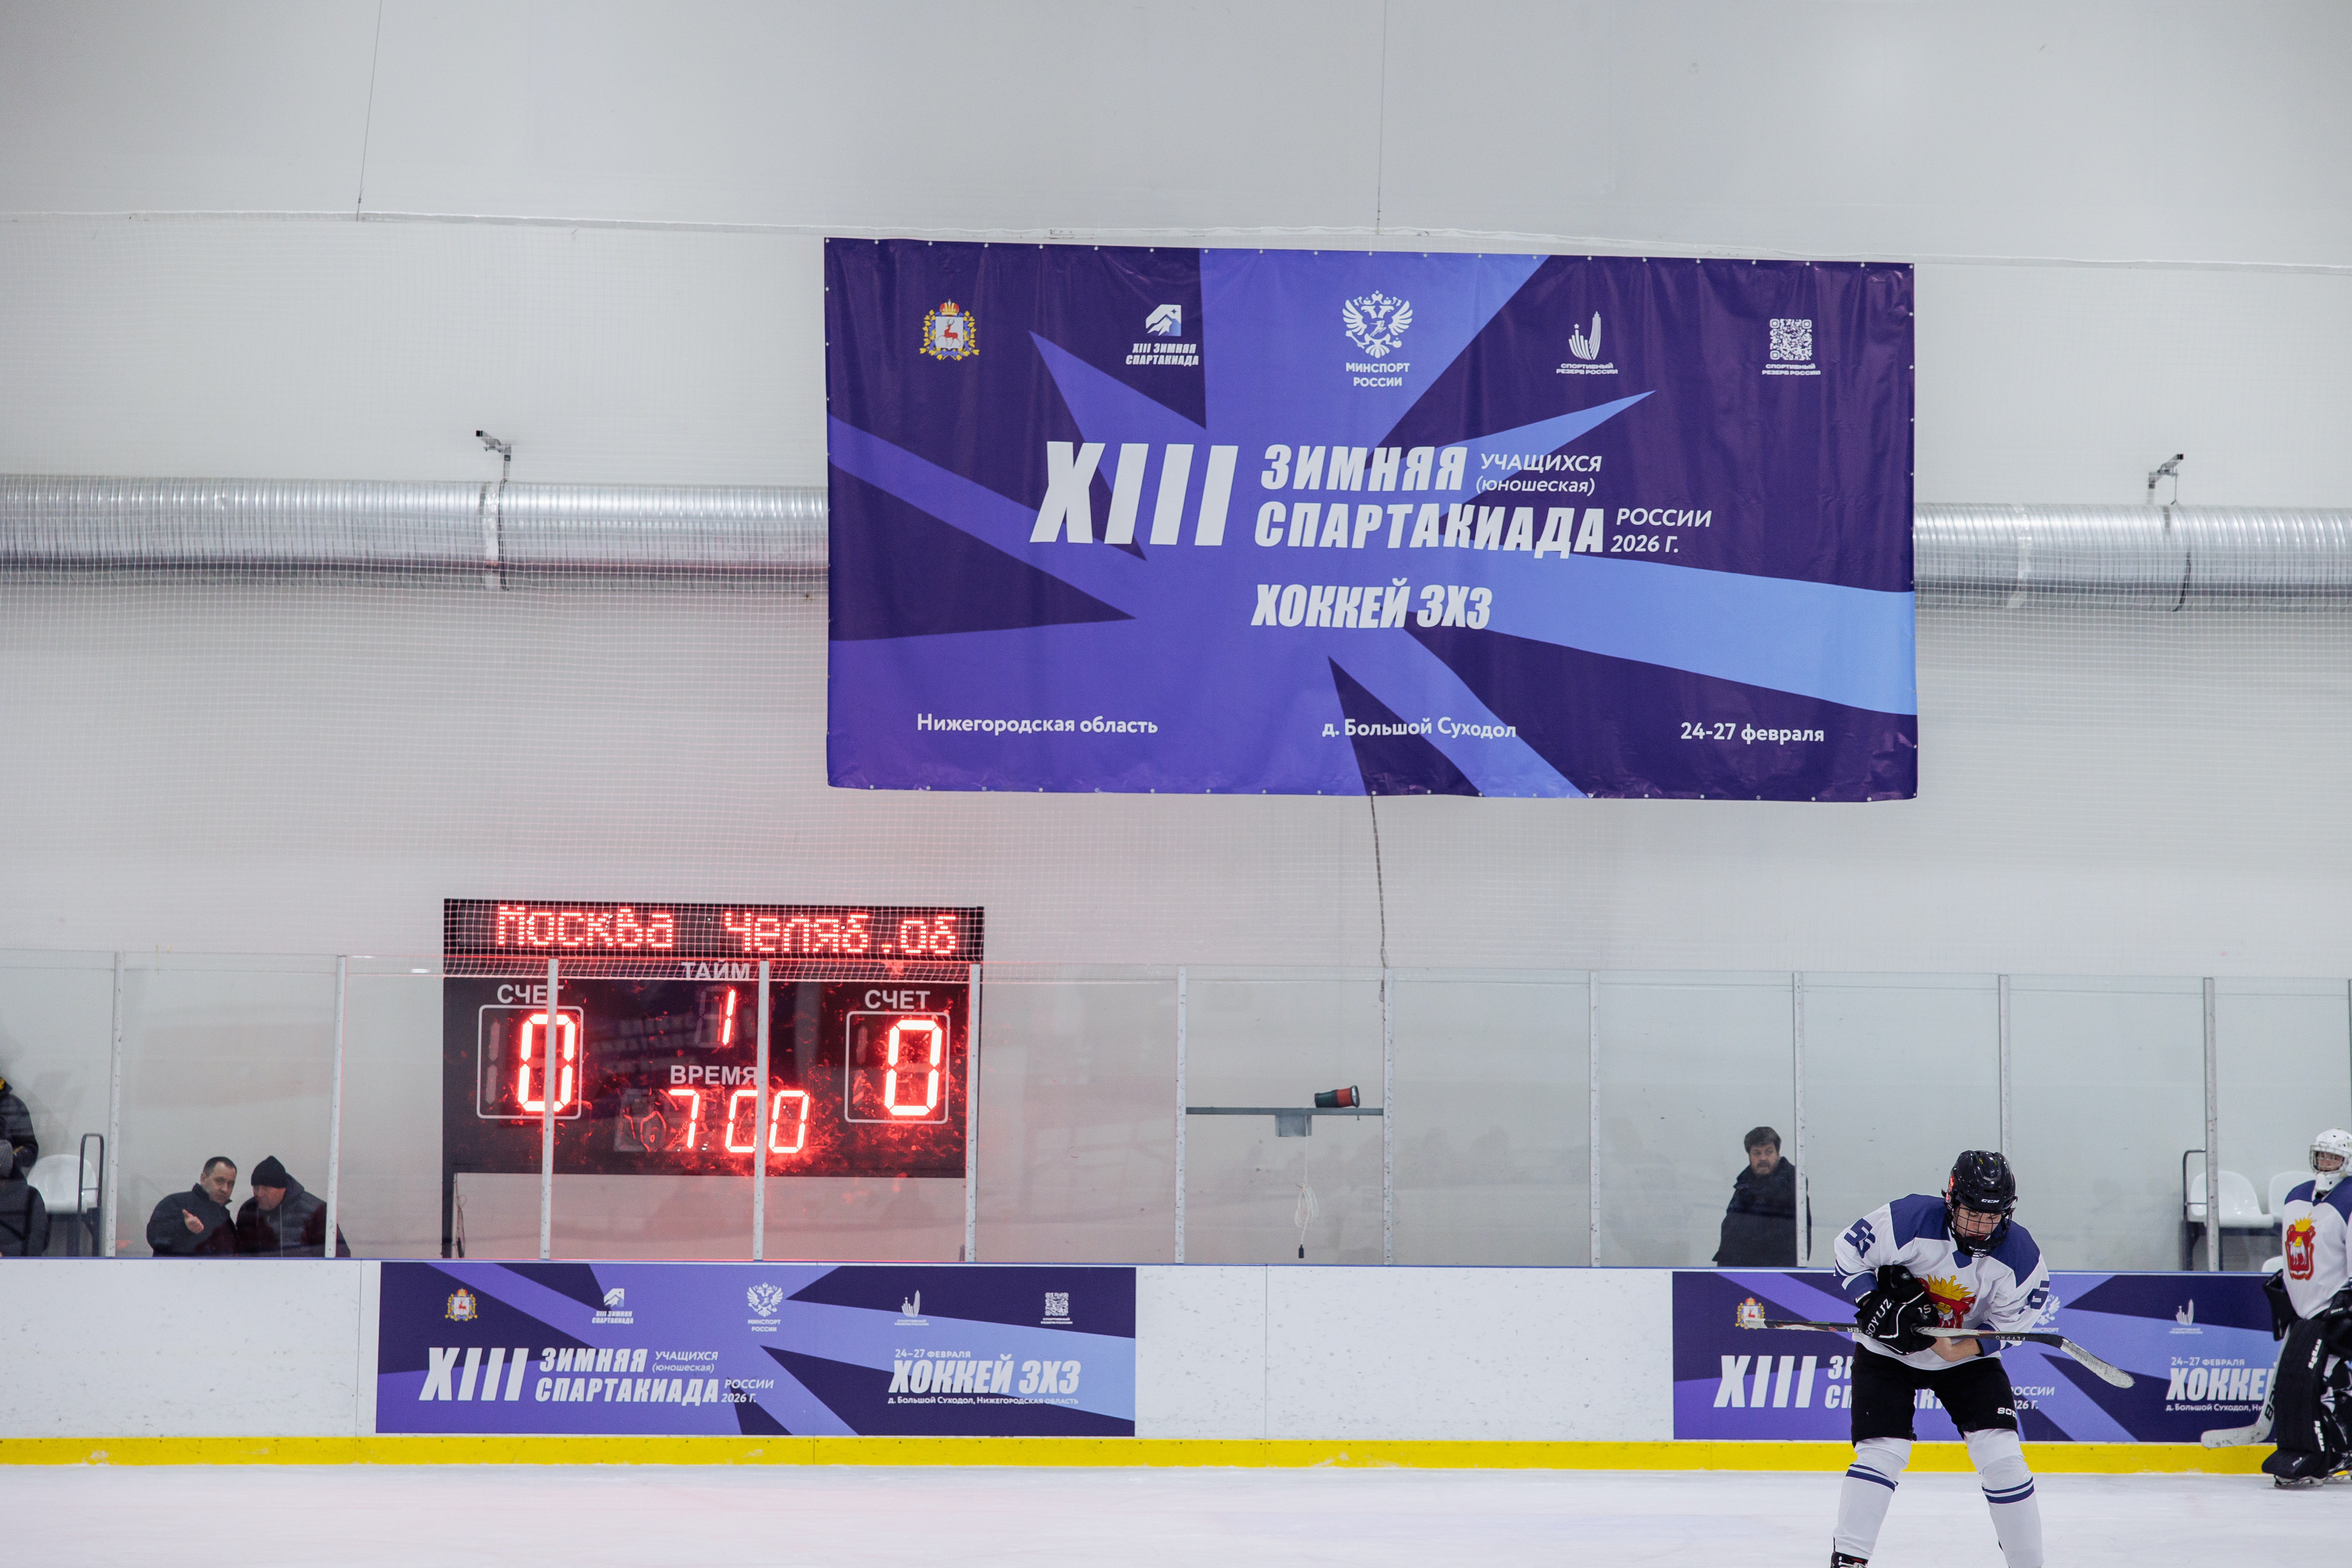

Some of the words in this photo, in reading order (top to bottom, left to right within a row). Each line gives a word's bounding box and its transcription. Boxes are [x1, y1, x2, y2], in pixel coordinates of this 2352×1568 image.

[1133, 343, 1151, 353] XIII
[1154, 343, 1196, 353] ЗИМНЯЯ
[1126, 355, 1198, 366] СПАРТАКИАДА
[1346, 363, 1410, 373] МИНСПОРТ
[1354, 377, 1402, 387] РОССИИ
[1030, 441, 1238, 546] XIII
[1261, 444, 1467, 491] ЗИМНЯЯ
[1481, 453, 1602, 473] УЧАЩИХСЯ
[1476, 476, 1595, 496] (юношеская)
[1255, 501, 1604, 559] СПАРТАКИАДА
[1617, 508, 1712, 527] РОССИИ
[1611, 535, 1659, 552] 2026
[1665, 536, 1678, 553] Г.
[1251, 578, 1410, 628] ХОККЕЙ
[918, 714, 1075, 735] Нижегородская
[1080, 716, 1158, 733] область
[1322, 724, 1339, 737] д.
[1345, 718, 1431, 735] Большой
[1438, 717, 1516, 739] Суходол
[1681, 722, 1736, 740] 24-27
[1741, 723, 1823, 745] февраля
[681, 959, 750, 979] ТАЙМ
[496, 984, 564, 1003] СЧЕ
[864, 989, 931, 1010] СЧЕТ
[722, 989, 736, 1046] 1
[518, 1013, 576, 1112] 0
[884, 1019, 943, 1116] 0
[669, 1065, 758, 1085] ВРЕМЯ
[1865, 1298, 1892, 1338] SOYUZ
[419, 1348, 529, 1400] XIII
[540, 1348, 648, 1372] ЗИМНЯЯ
[656, 1351, 718, 1361] УЧАЩИХСЯ
[652, 1363, 715, 1373] (юношеская)
[888, 1354, 1015, 1393] ХОККЕЙ
[536, 1378, 719, 1406] СПАРТАКИАДА
[725, 1379, 774, 1388] РОССИИ
[1714, 1355, 1817, 1408] XIII
[721, 1393, 746, 1402] 2026
[750, 1393, 756, 1402] Г.
[2014, 1400, 2029, 1410] 26
[2030, 1400, 2039, 1410] Г.
